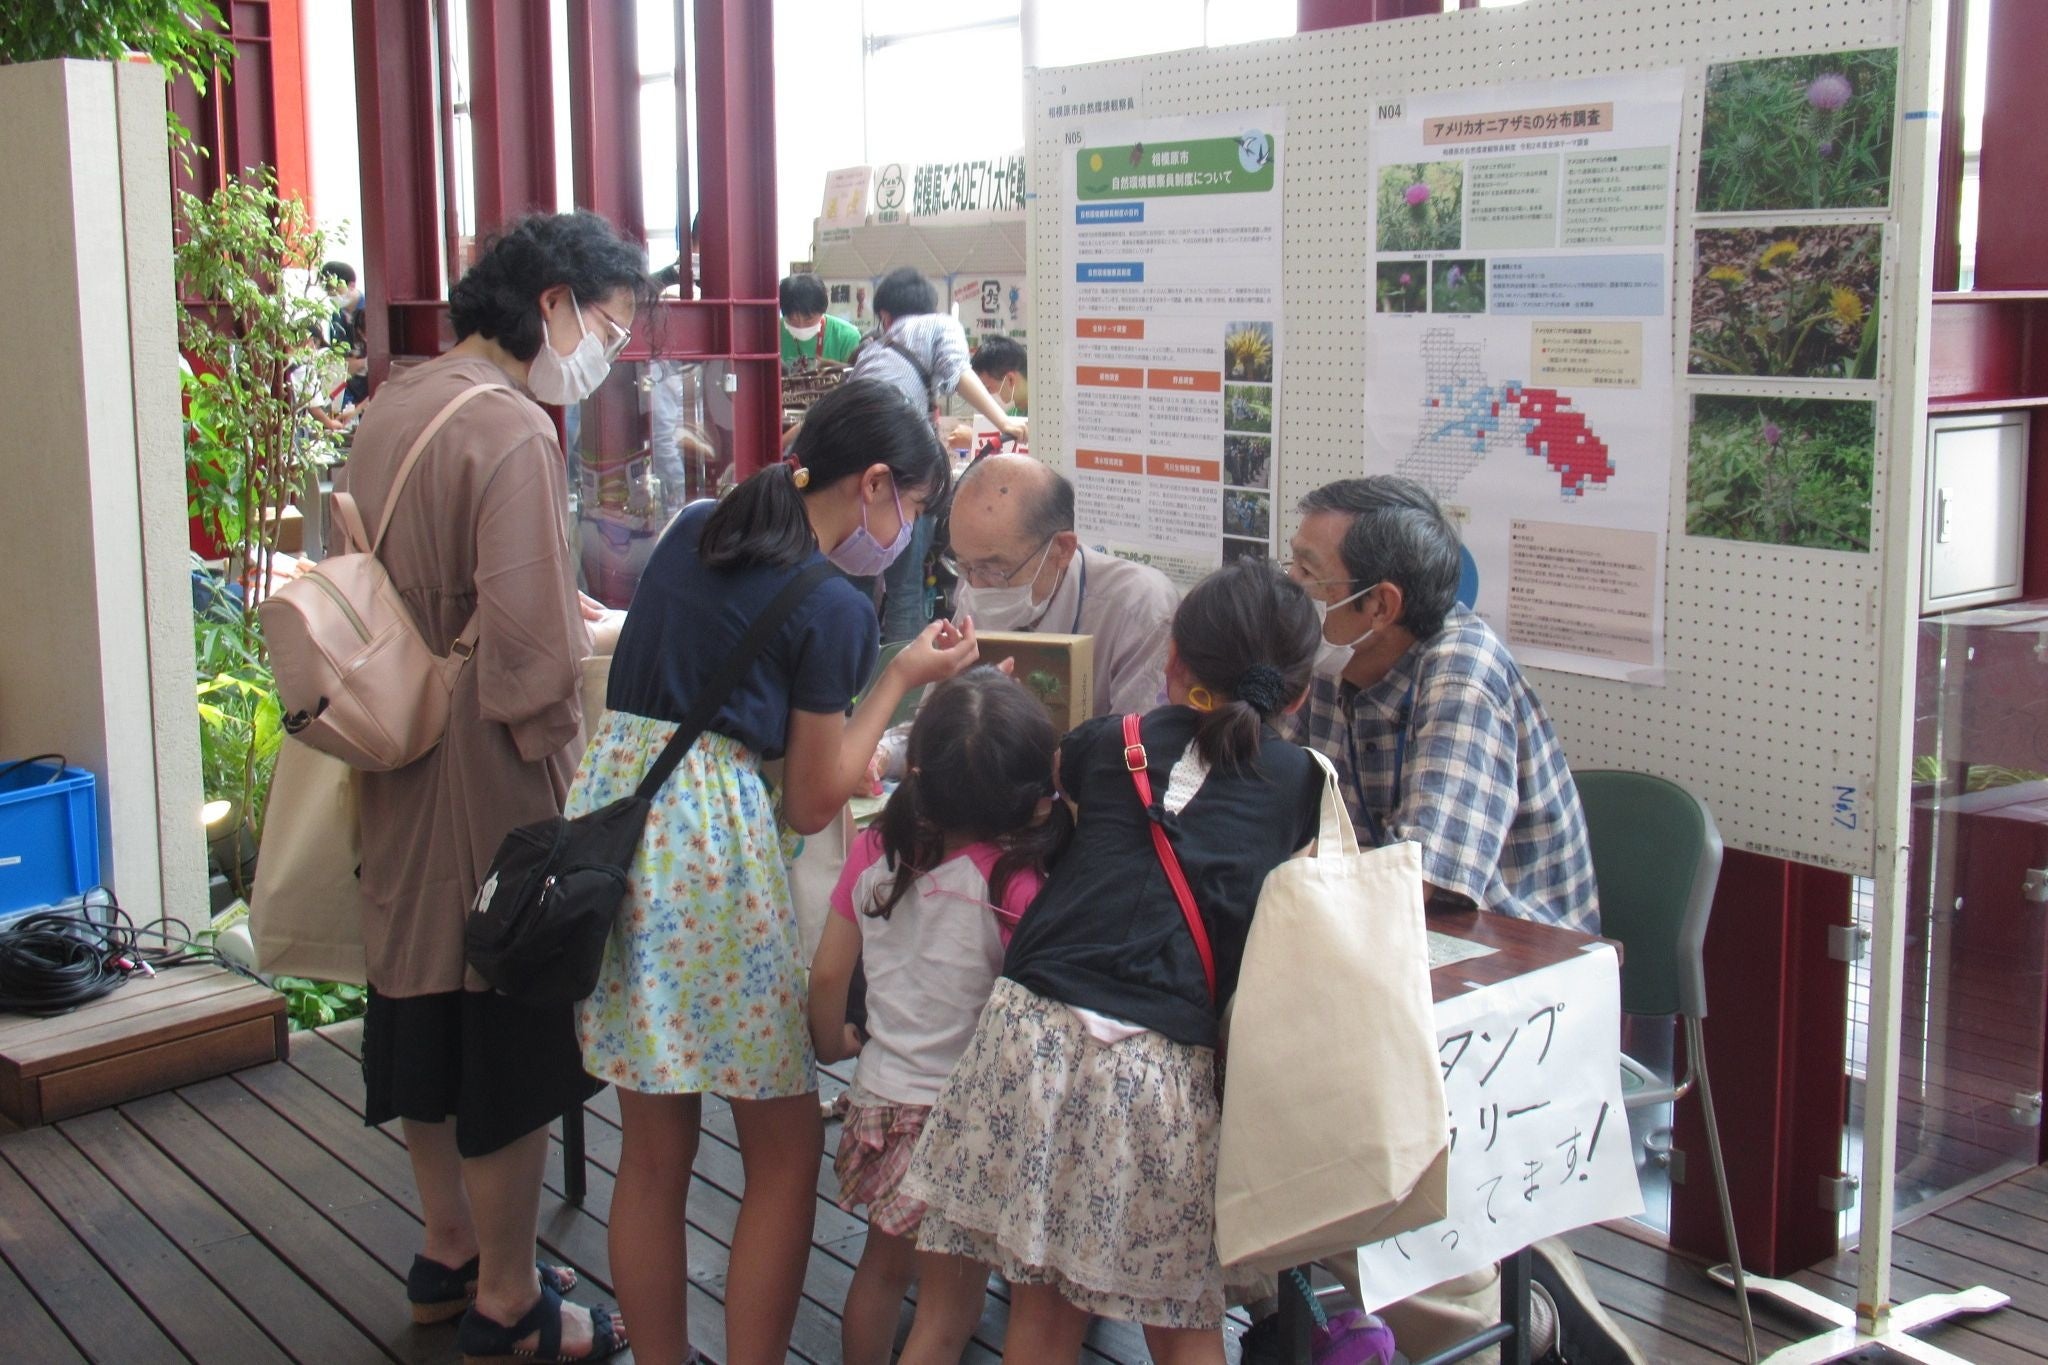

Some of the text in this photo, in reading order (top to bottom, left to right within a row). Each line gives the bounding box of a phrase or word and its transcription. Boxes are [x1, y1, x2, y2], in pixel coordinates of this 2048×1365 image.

[1433, 108, 1601, 138] アメリカオニアザミの分布調査
[1151, 151, 1189, 168] 相模原市
[1112, 170, 1233, 191] 自然環境観察員制度について
